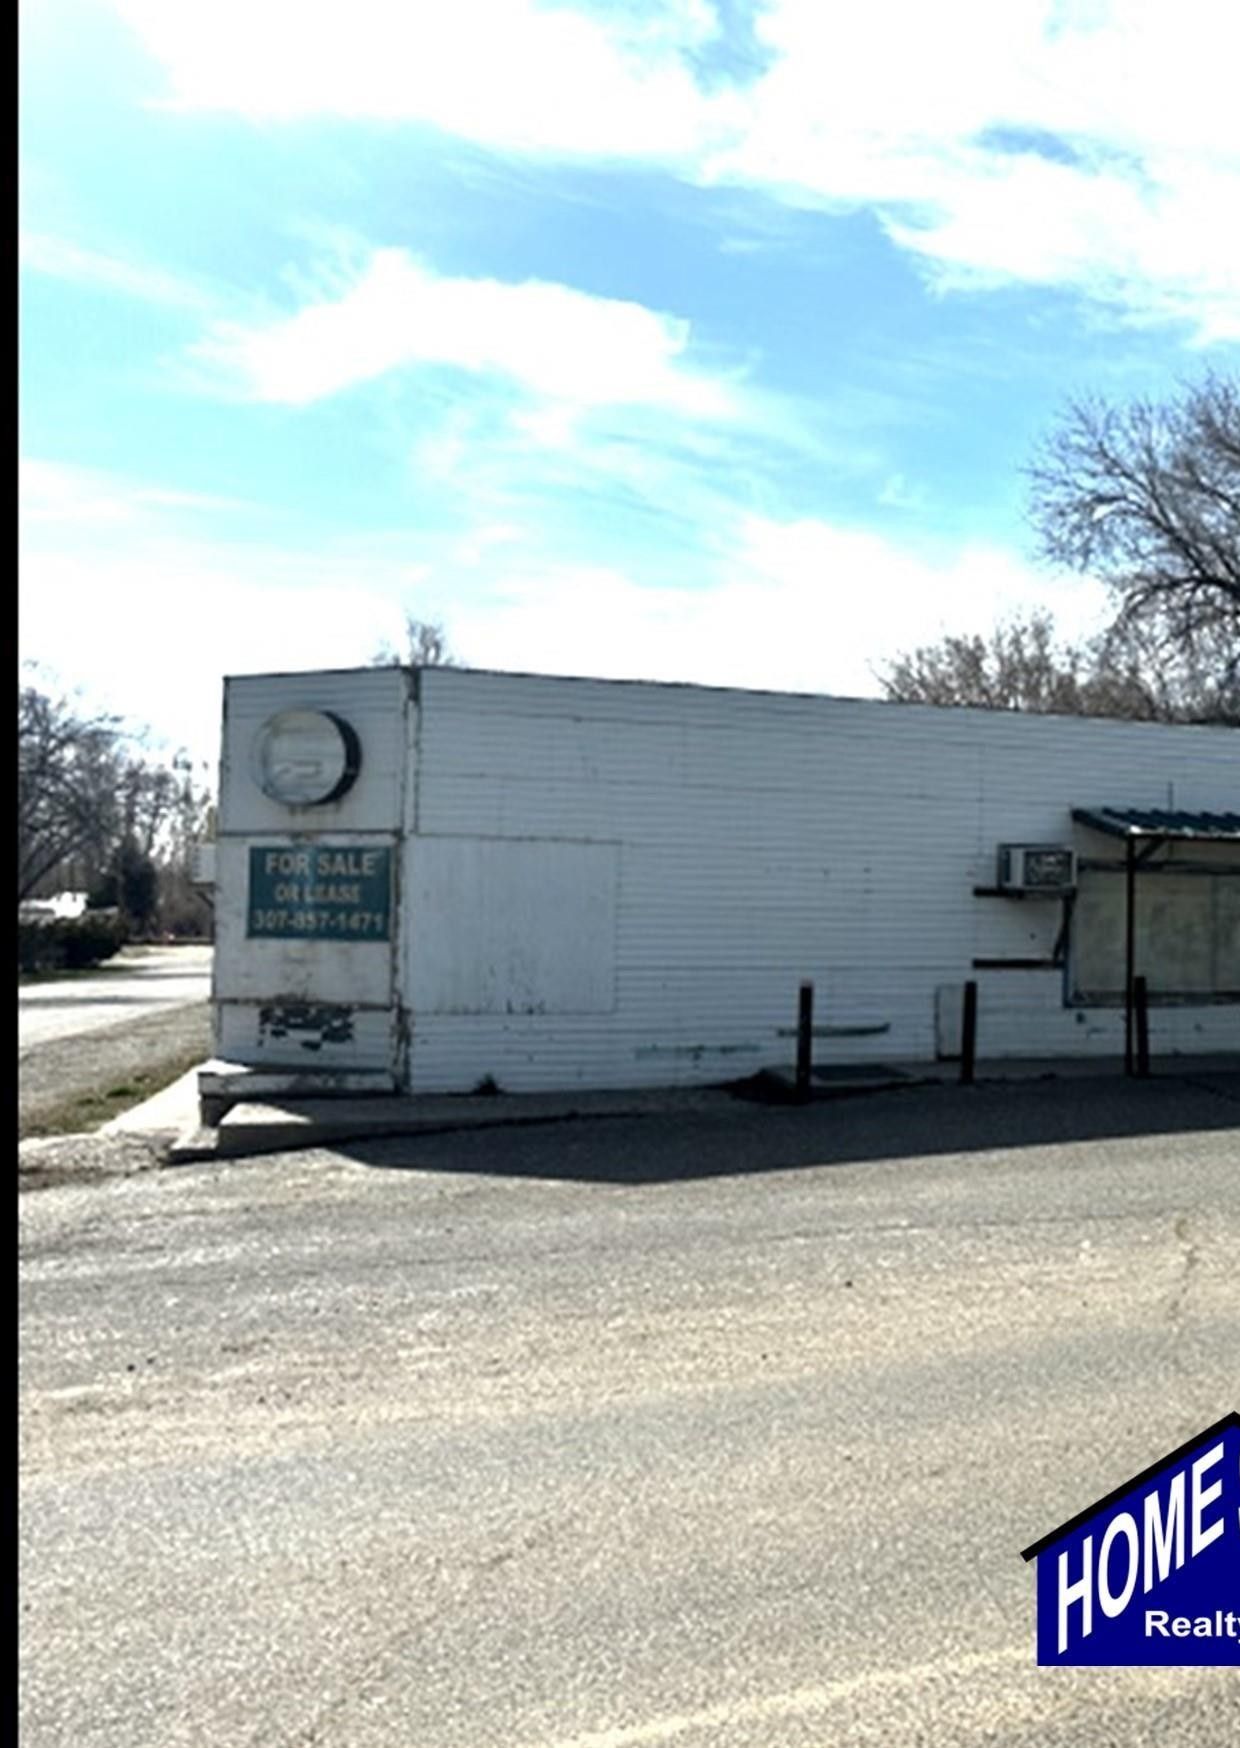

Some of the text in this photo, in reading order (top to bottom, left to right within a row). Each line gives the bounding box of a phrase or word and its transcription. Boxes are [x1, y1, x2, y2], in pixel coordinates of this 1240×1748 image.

[265, 852, 376, 876] FOR SALE
[274, 882, 361, 904] OR LEASE
